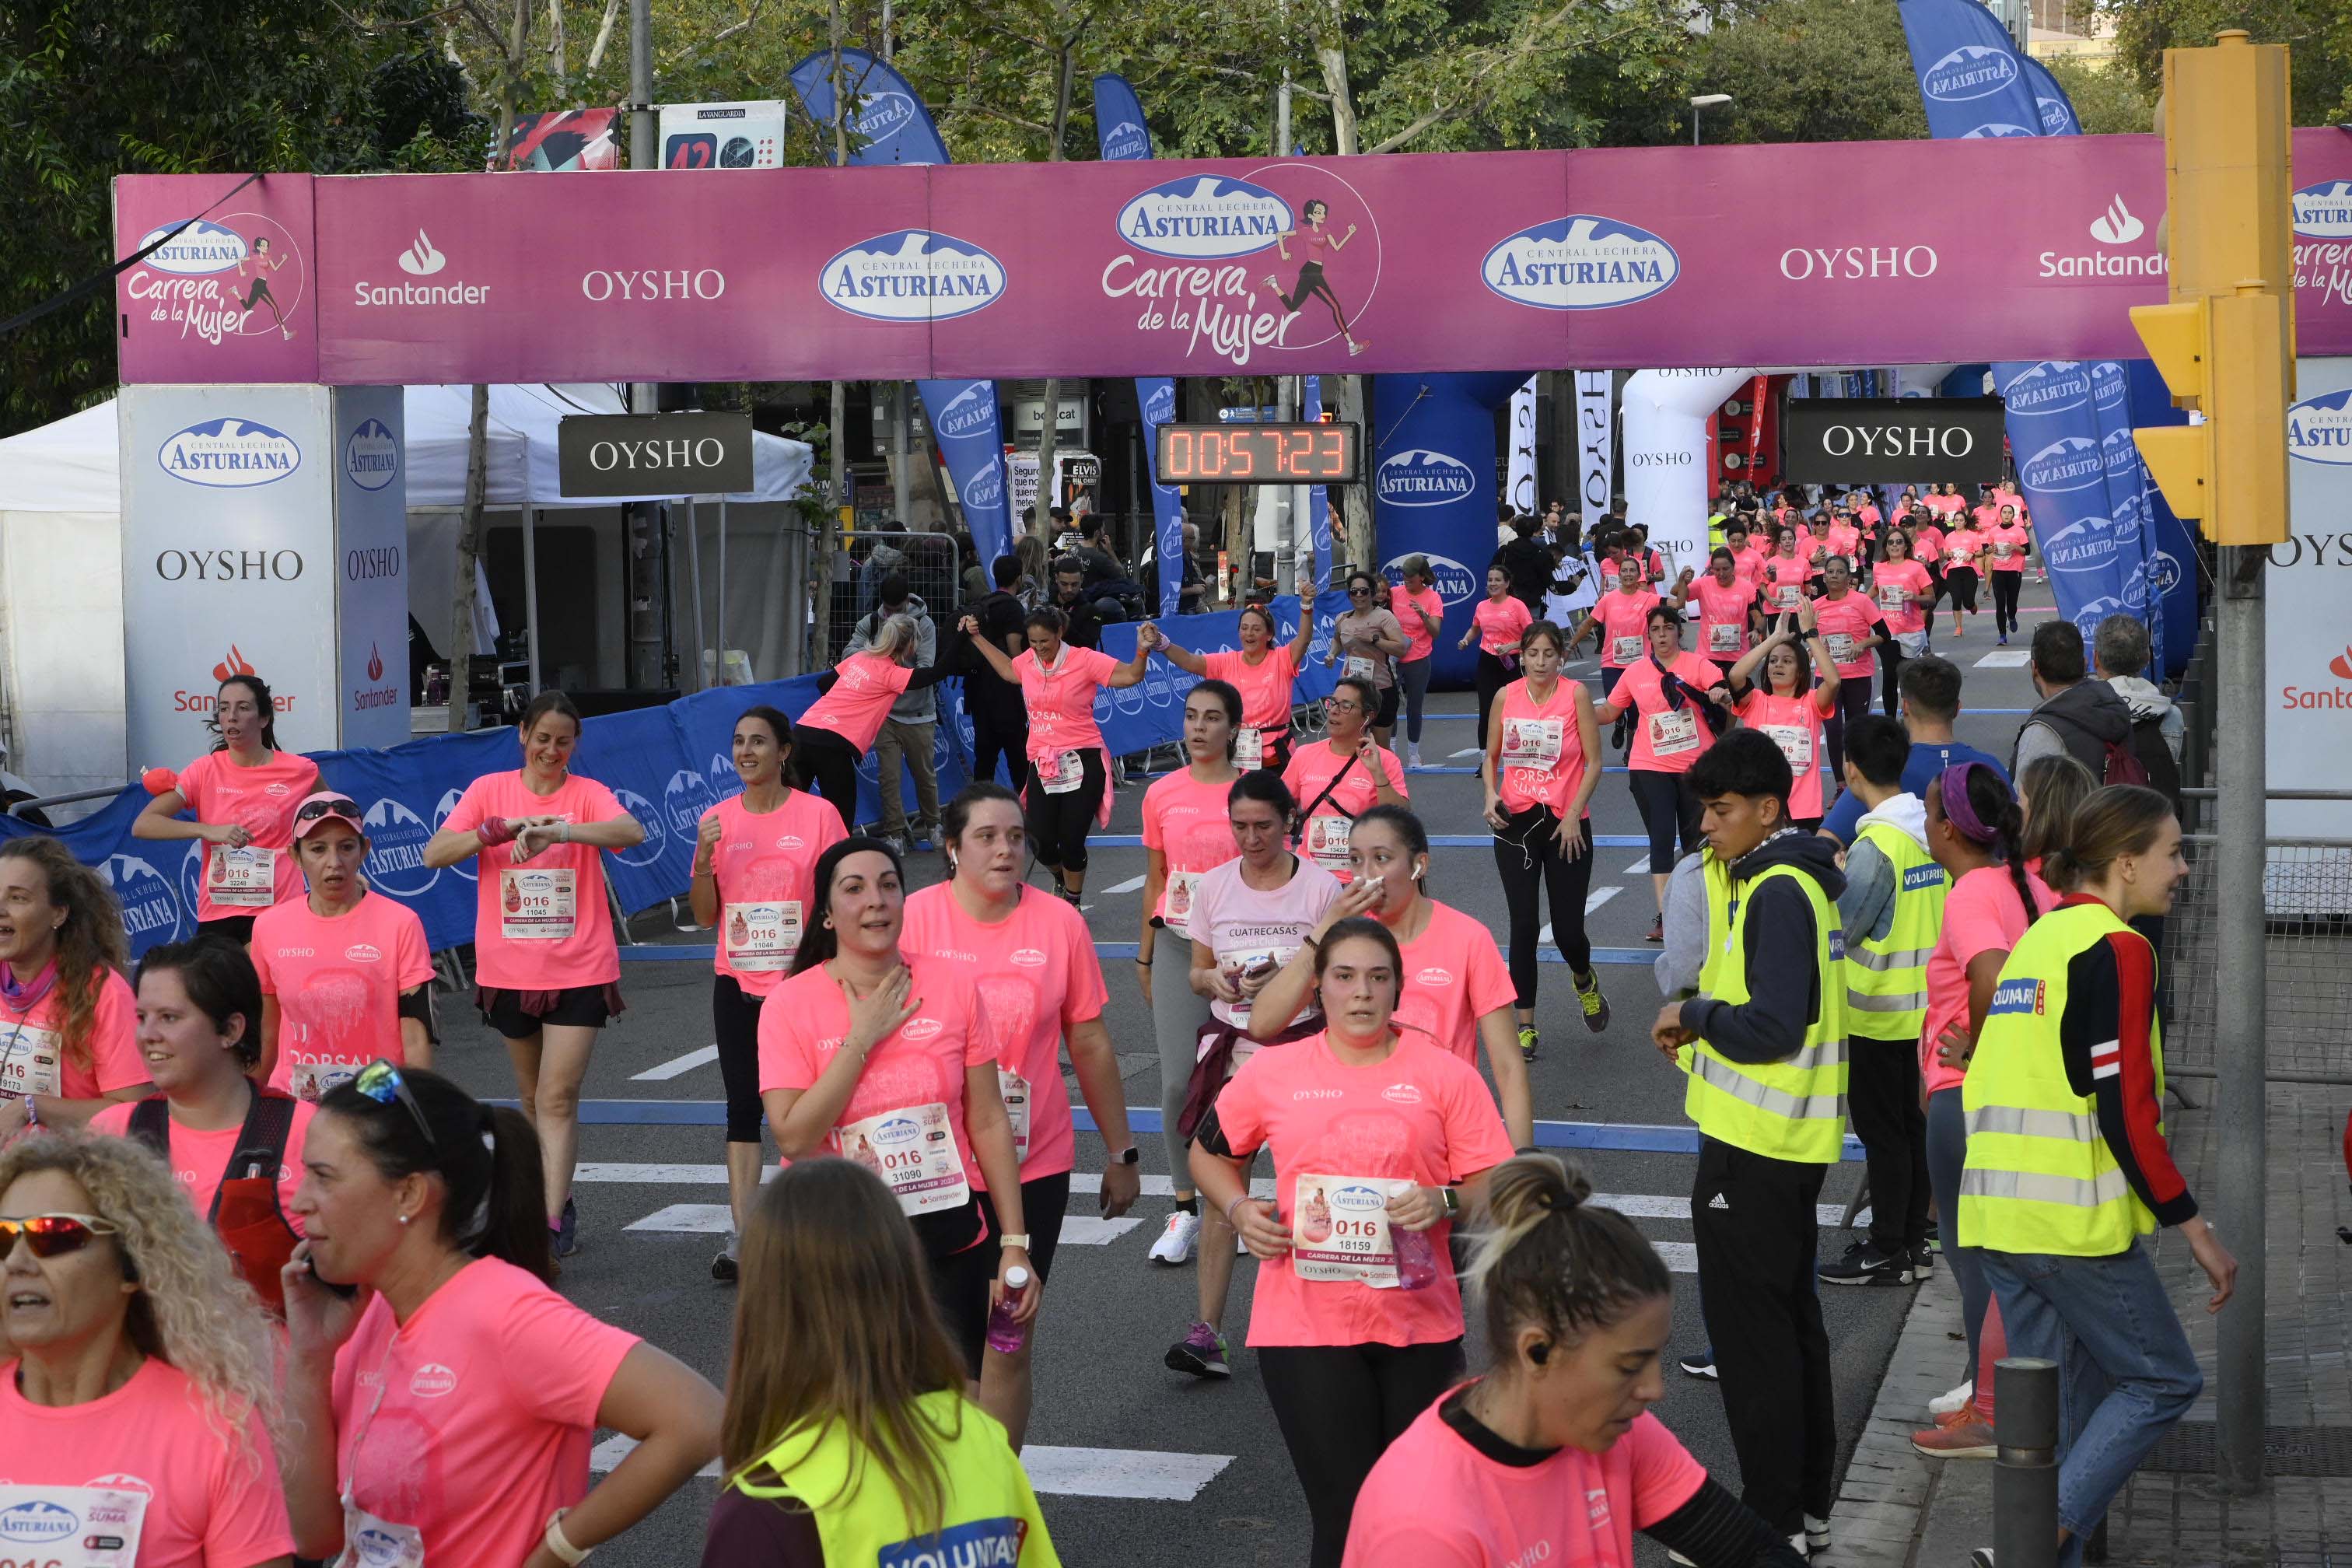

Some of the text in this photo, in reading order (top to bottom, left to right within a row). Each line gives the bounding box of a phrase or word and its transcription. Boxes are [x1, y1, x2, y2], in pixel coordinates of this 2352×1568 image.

[705, 109, 745, 118] VANGUARDIA
[1219, 203, 1275, 212] LECHERA
[1131, 207, 1279, 238] ASTURIANA
[1527, 247, 1657, 258] CENTRAL LECHERA
[862, 260, 987, 271] CENTRAL LECHERA
[1496, 251, 1664, 287] ASTURIANA
[1780, 245, 1937, 280] OYSHO
[2039, 251, 2168, 277] Santand
[833, 264, 992, 298] ASTURIANA
[1101, 255, 1248, 298] Carrera
[2312, 266, 2326, 289] la
[128, 271, 219, 299] Carrera
[582, 269, 726, 302] OYSHO
[355, 281, 490, 306] Santander
[150, 298, 254, 345] de la Mujer
[1137, 292, 1301, 366] de la Mujer
[1034, 409, 1075, 420] bc.cat
[1822, 425, 1973, 457] OYSHO
[169, 443, 291, 471] ASTURIANA
[350, 446, 395, 472] ASTURIANA
[590, 438, 724, 471] OYSHO
[1169, 432, 1342, 474] 00:57:23
[1633, 451, 1692, 467] OYSHO
[1073, 465, 1097, 475] ELVIS
[1380, 473, 1468, 494] ASTURIANA
[156, 549, 303, 581] OYSHO
[348, 546, 399, 581] OYSHO
[174, 690, 296, 712] Saner
[355, 686, 398, 712] Santander
[1665, 726, 1681, 735] 016
[1167, 807, 1199, 815] OYSHO
[726, 842, 753, 852] OYSHO
[777, 839, 802, 848] ASTURIANA
[1328, 837, 1349, 845] 016
[523, 897, 549, 906] 016
[751, 929, 776, 939] 016
[1229, 926, 1298, 937] CUATRECASAS
[1259, 936, 1280, 946] Club
[278, 947, 314, 957] OYSHO
[347, 950, 380, 960] ASTURIANA
[936, 949, 977, 964] OYSHO
[1012, 954, 1047, 965] ASTURIANA
[1417, 975, 1452, 984] ASTURIANA
[2037, 980, 2046, 1015] 2000
[902, 1020, 942, 1038] ASTURIANA
[1293, 1089, 1344, 1101] OYSHO
[877, 1129, 917, 1141] ASTURIANA
[884, 1150, 922, 1169] 016
[892, 1169, 922, 1182] 31090
[918, 1181, 938, 1189] MUJER
[928, 1192, 962, 1203] Santander
[1336, 1194, 1380, 1206] ASTURIANA
[1336, 1220, 1377, 1237] 016
[1339, 1241, 1370, 1251] 18159
[1307, 1252, 1339, 1261] CARRERA
[1304, 1265, 1341, 1275] OYSHO
[0, 1517, 71, 1532] ASTURIANA
[87, 1514, 126, 1523] SUMA
